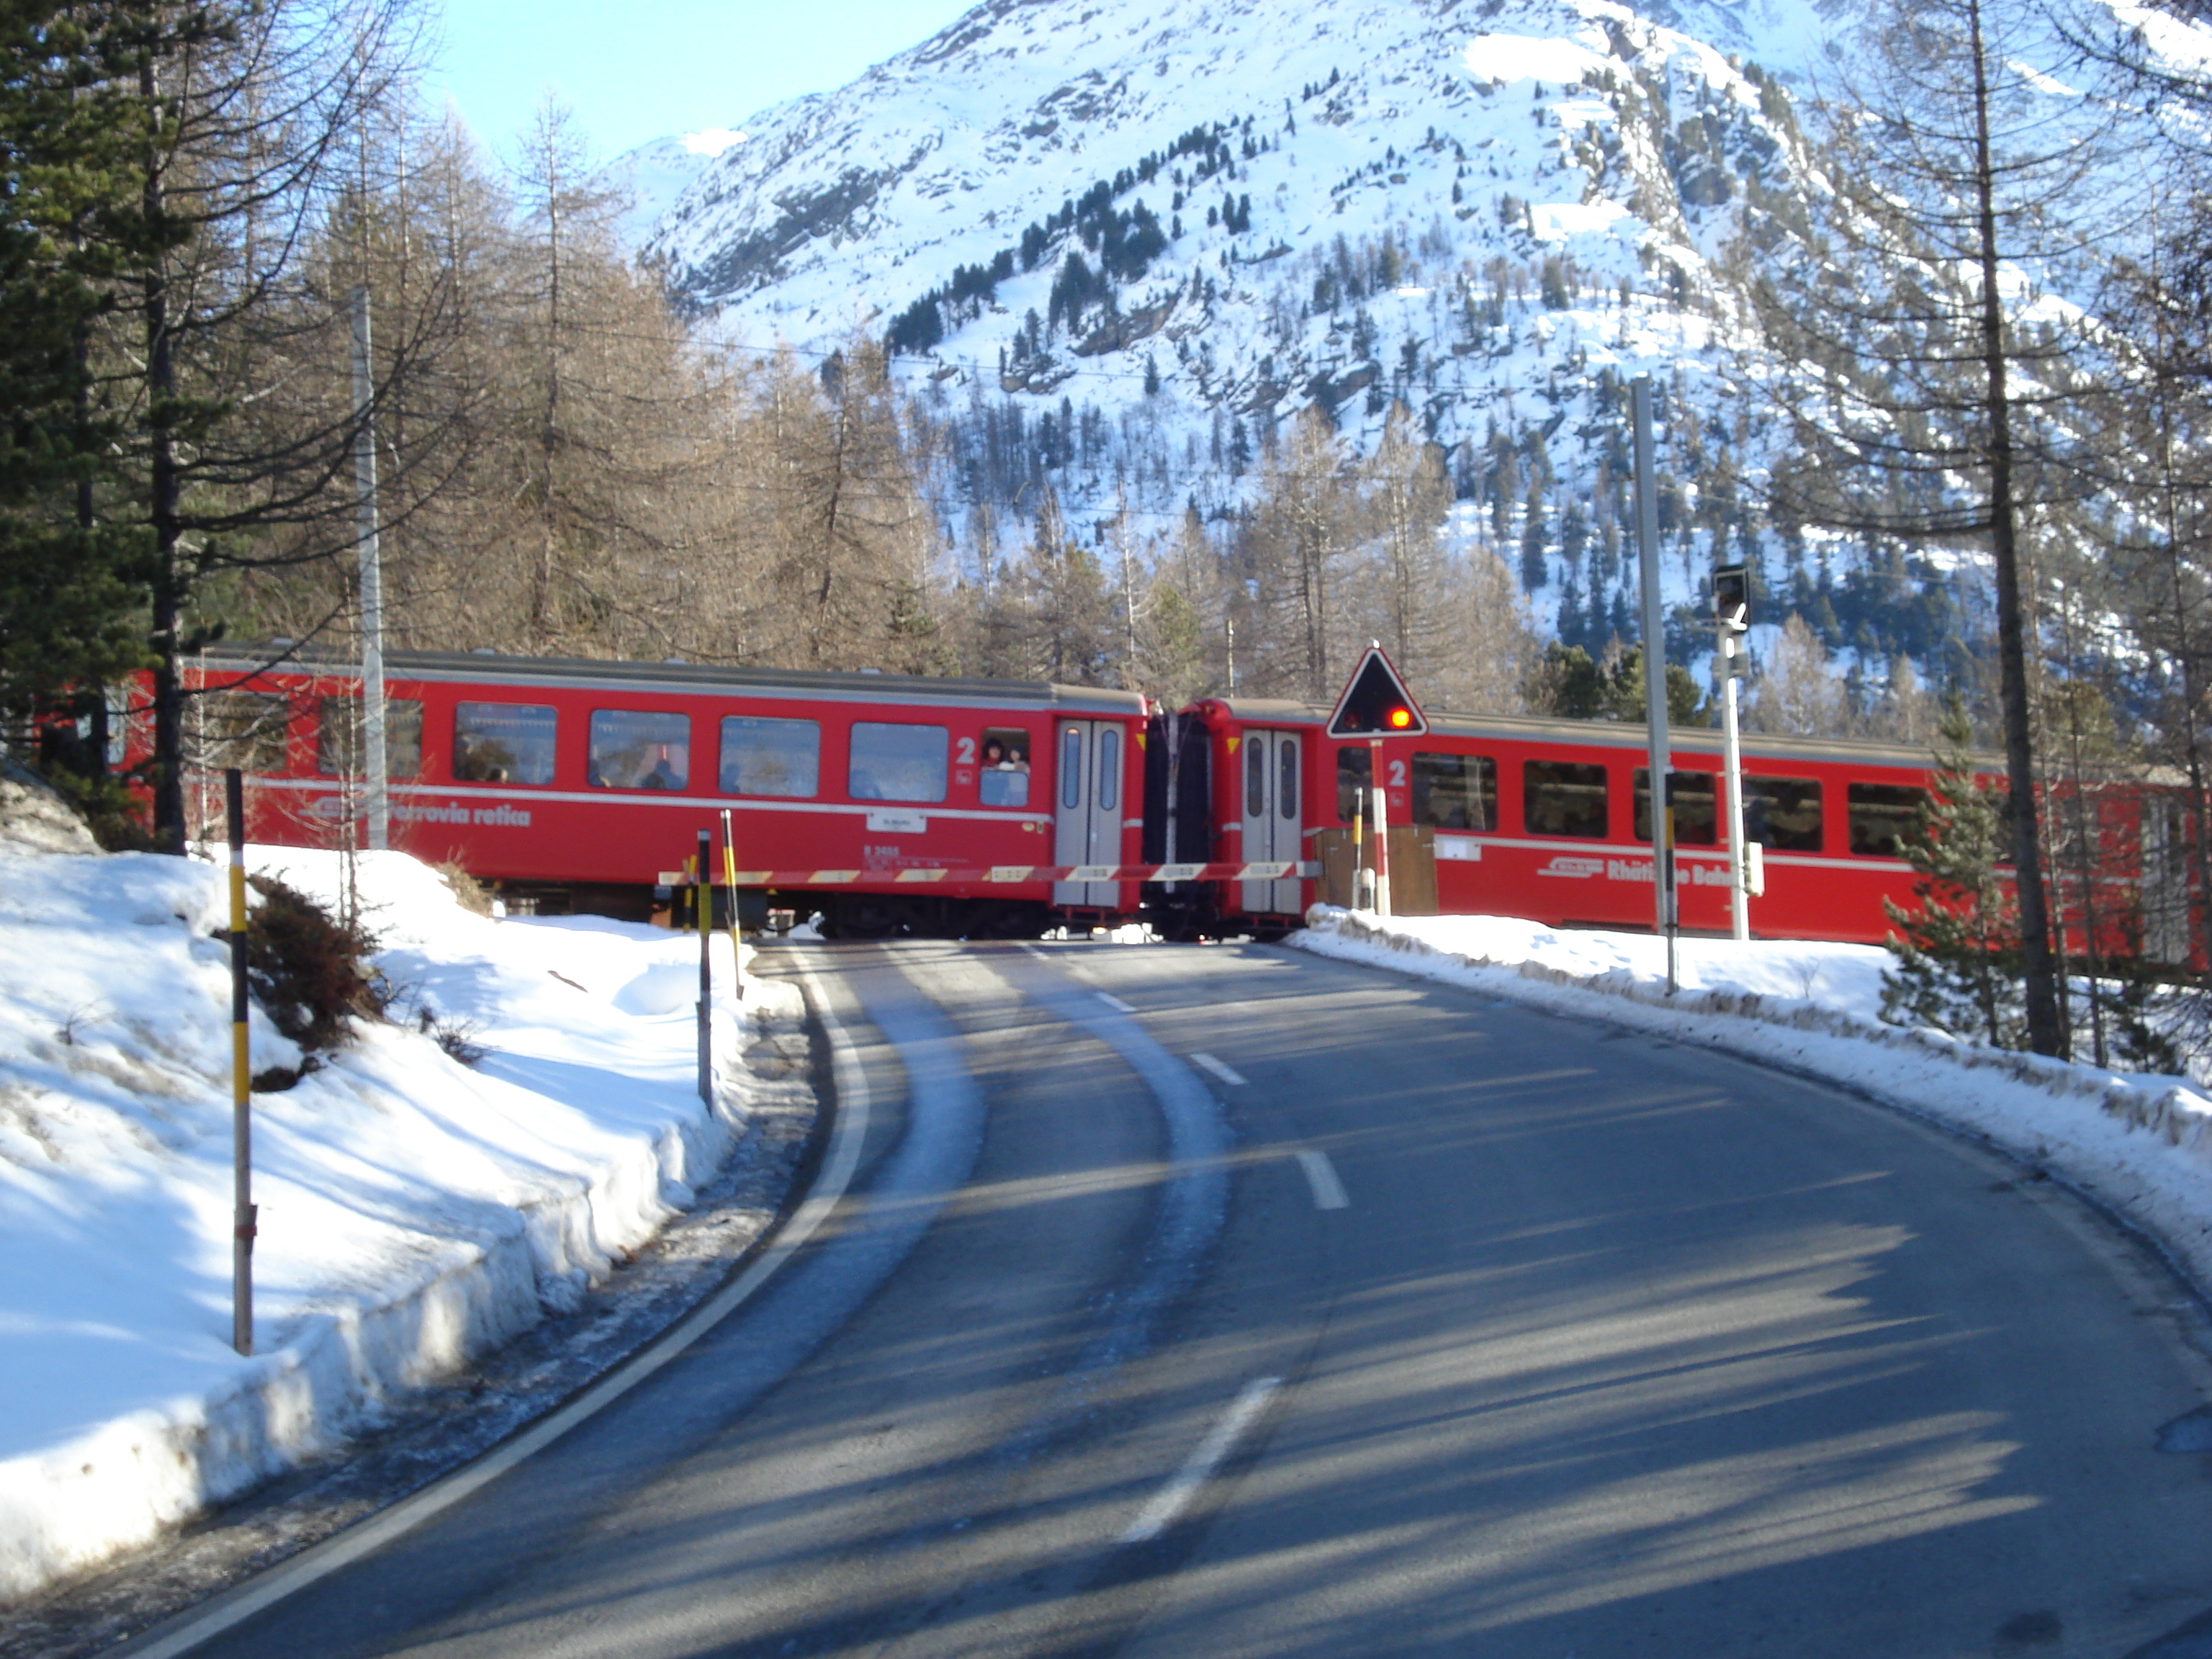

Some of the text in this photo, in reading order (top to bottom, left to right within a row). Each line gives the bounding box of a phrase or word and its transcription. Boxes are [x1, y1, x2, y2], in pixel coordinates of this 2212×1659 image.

[956, 737, 976, 765] 2
[1389, 760, 1406, 786] 2
[473, 804, 531, 827] retica
